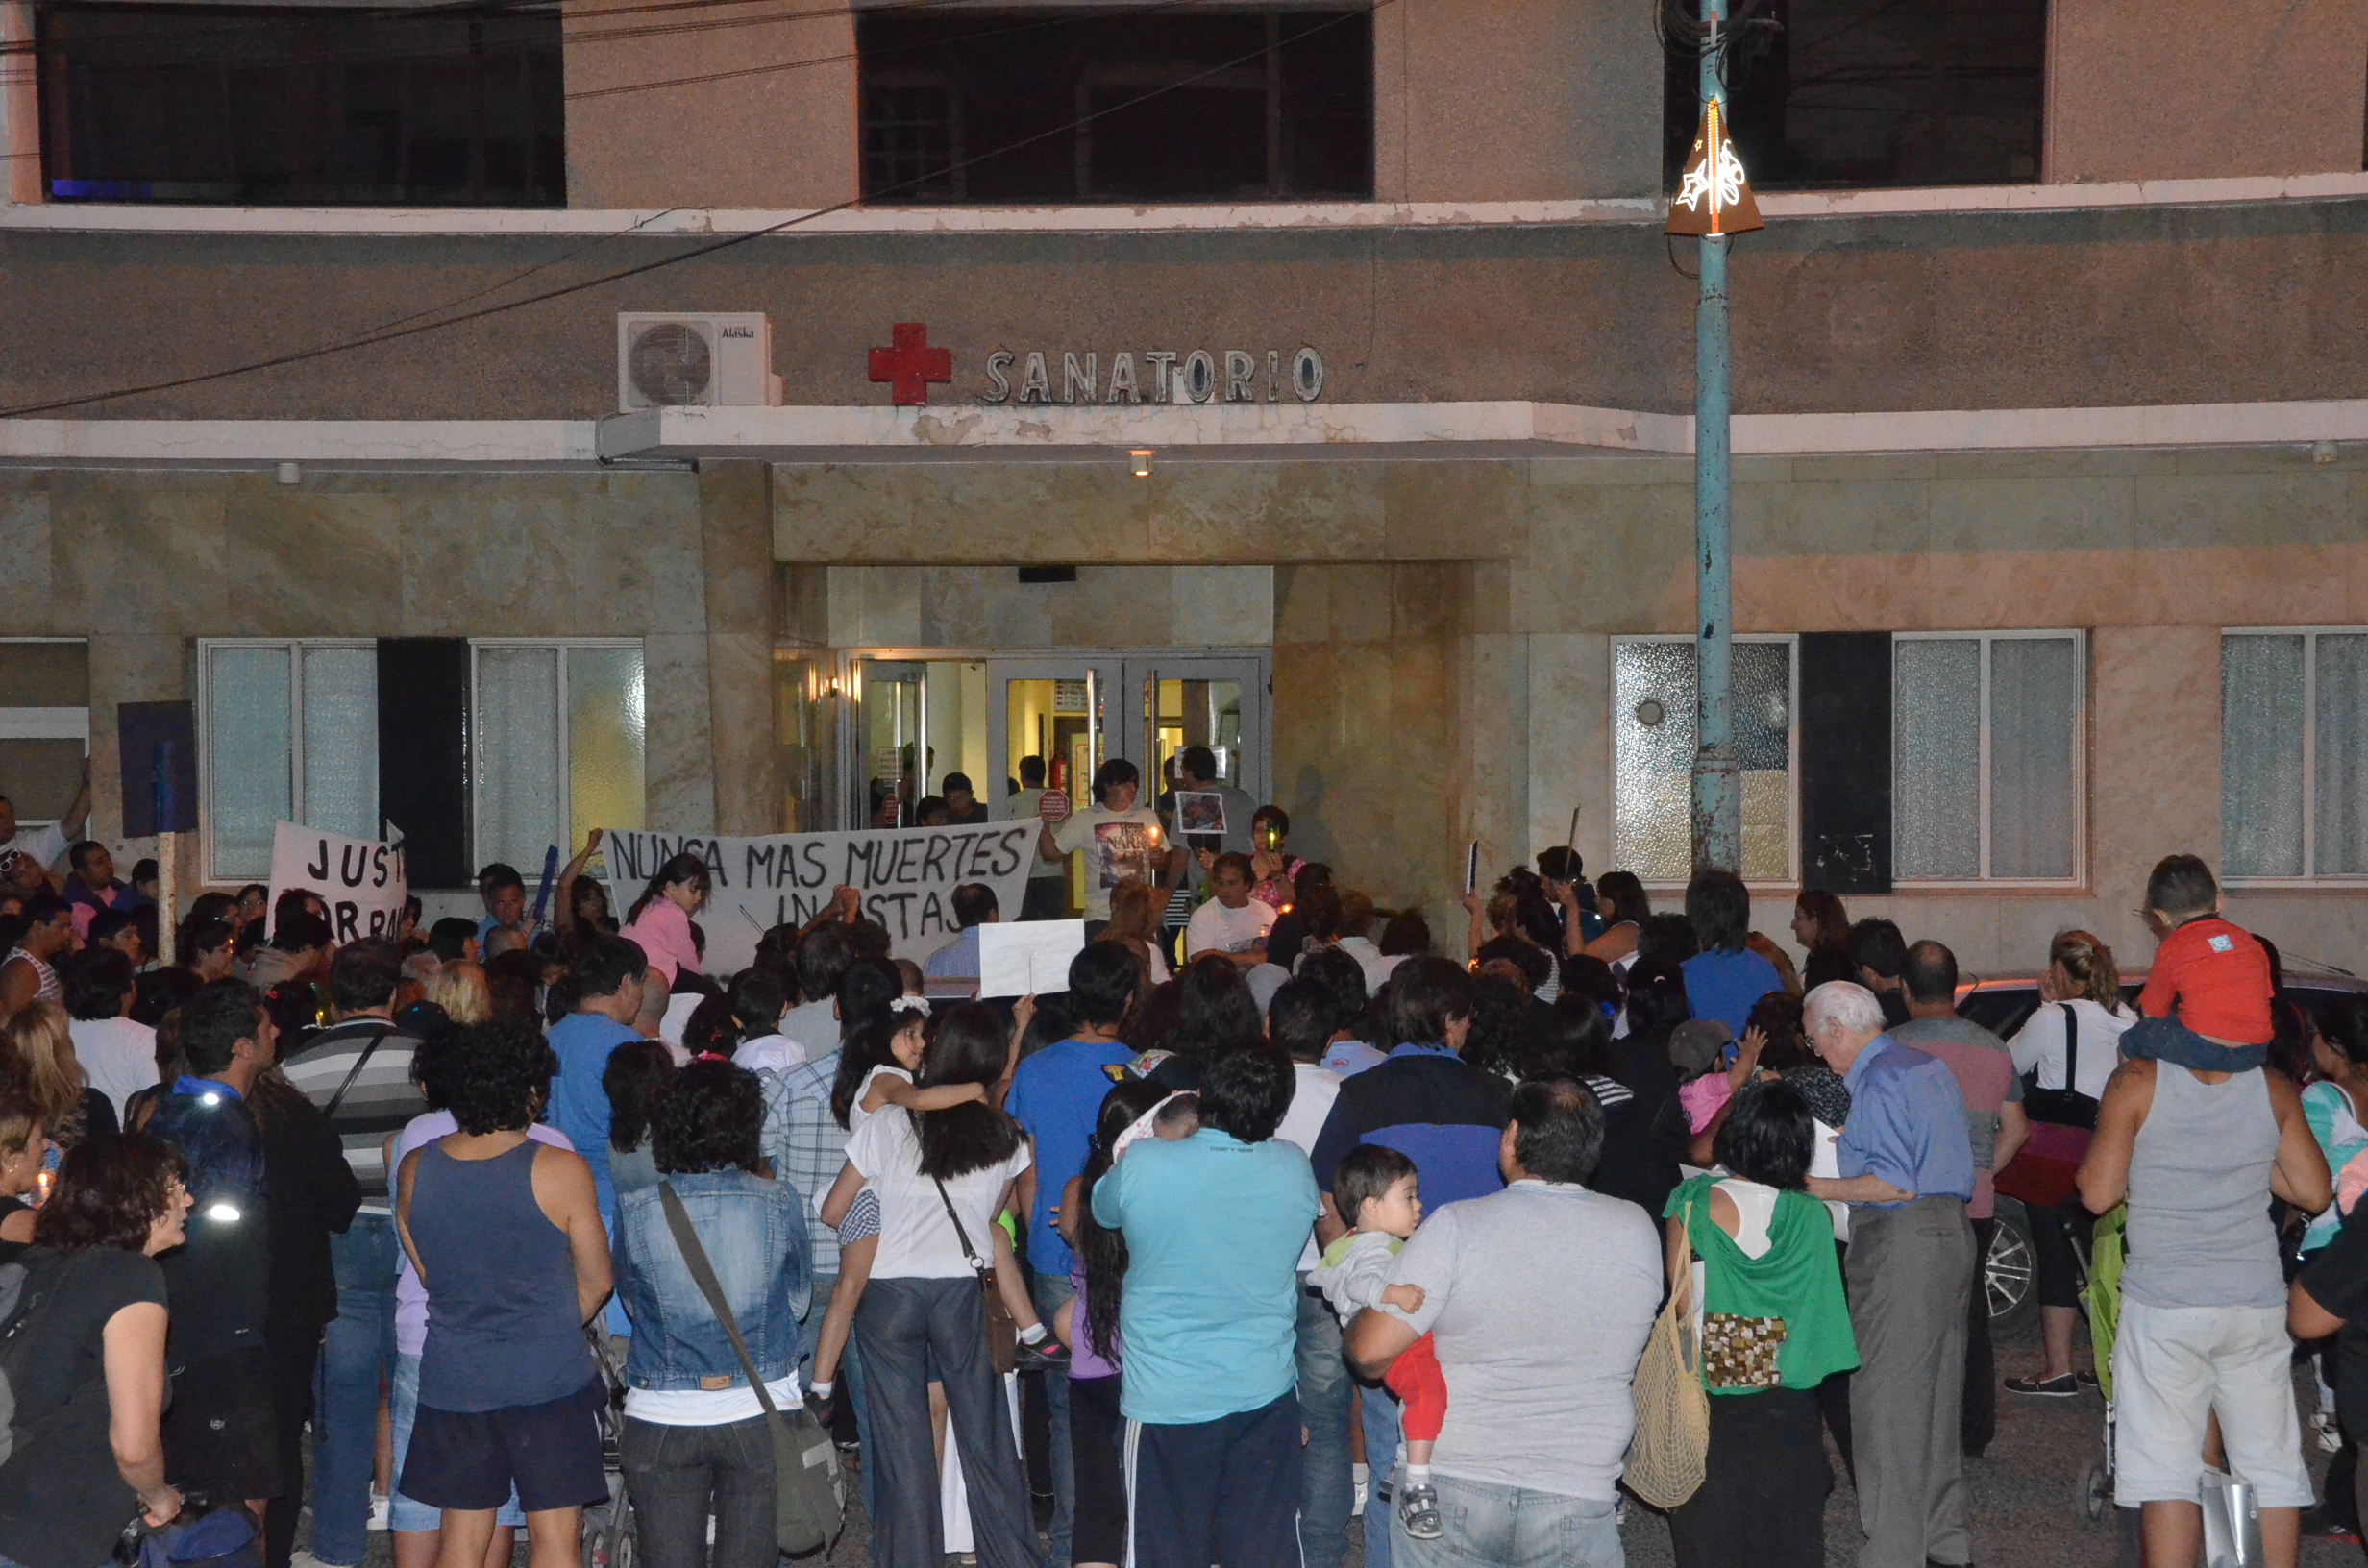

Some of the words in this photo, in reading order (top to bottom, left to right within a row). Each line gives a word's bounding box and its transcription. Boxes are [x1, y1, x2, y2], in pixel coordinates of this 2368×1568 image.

[722, 327, 754, 338] Alaska
[983, 347, 1324, 403] SANATORIO
[308, 839, 406, 888] JUST
[747, 842, 826, 889] MAS
[845, 828, 1025, 889] MUERTES
